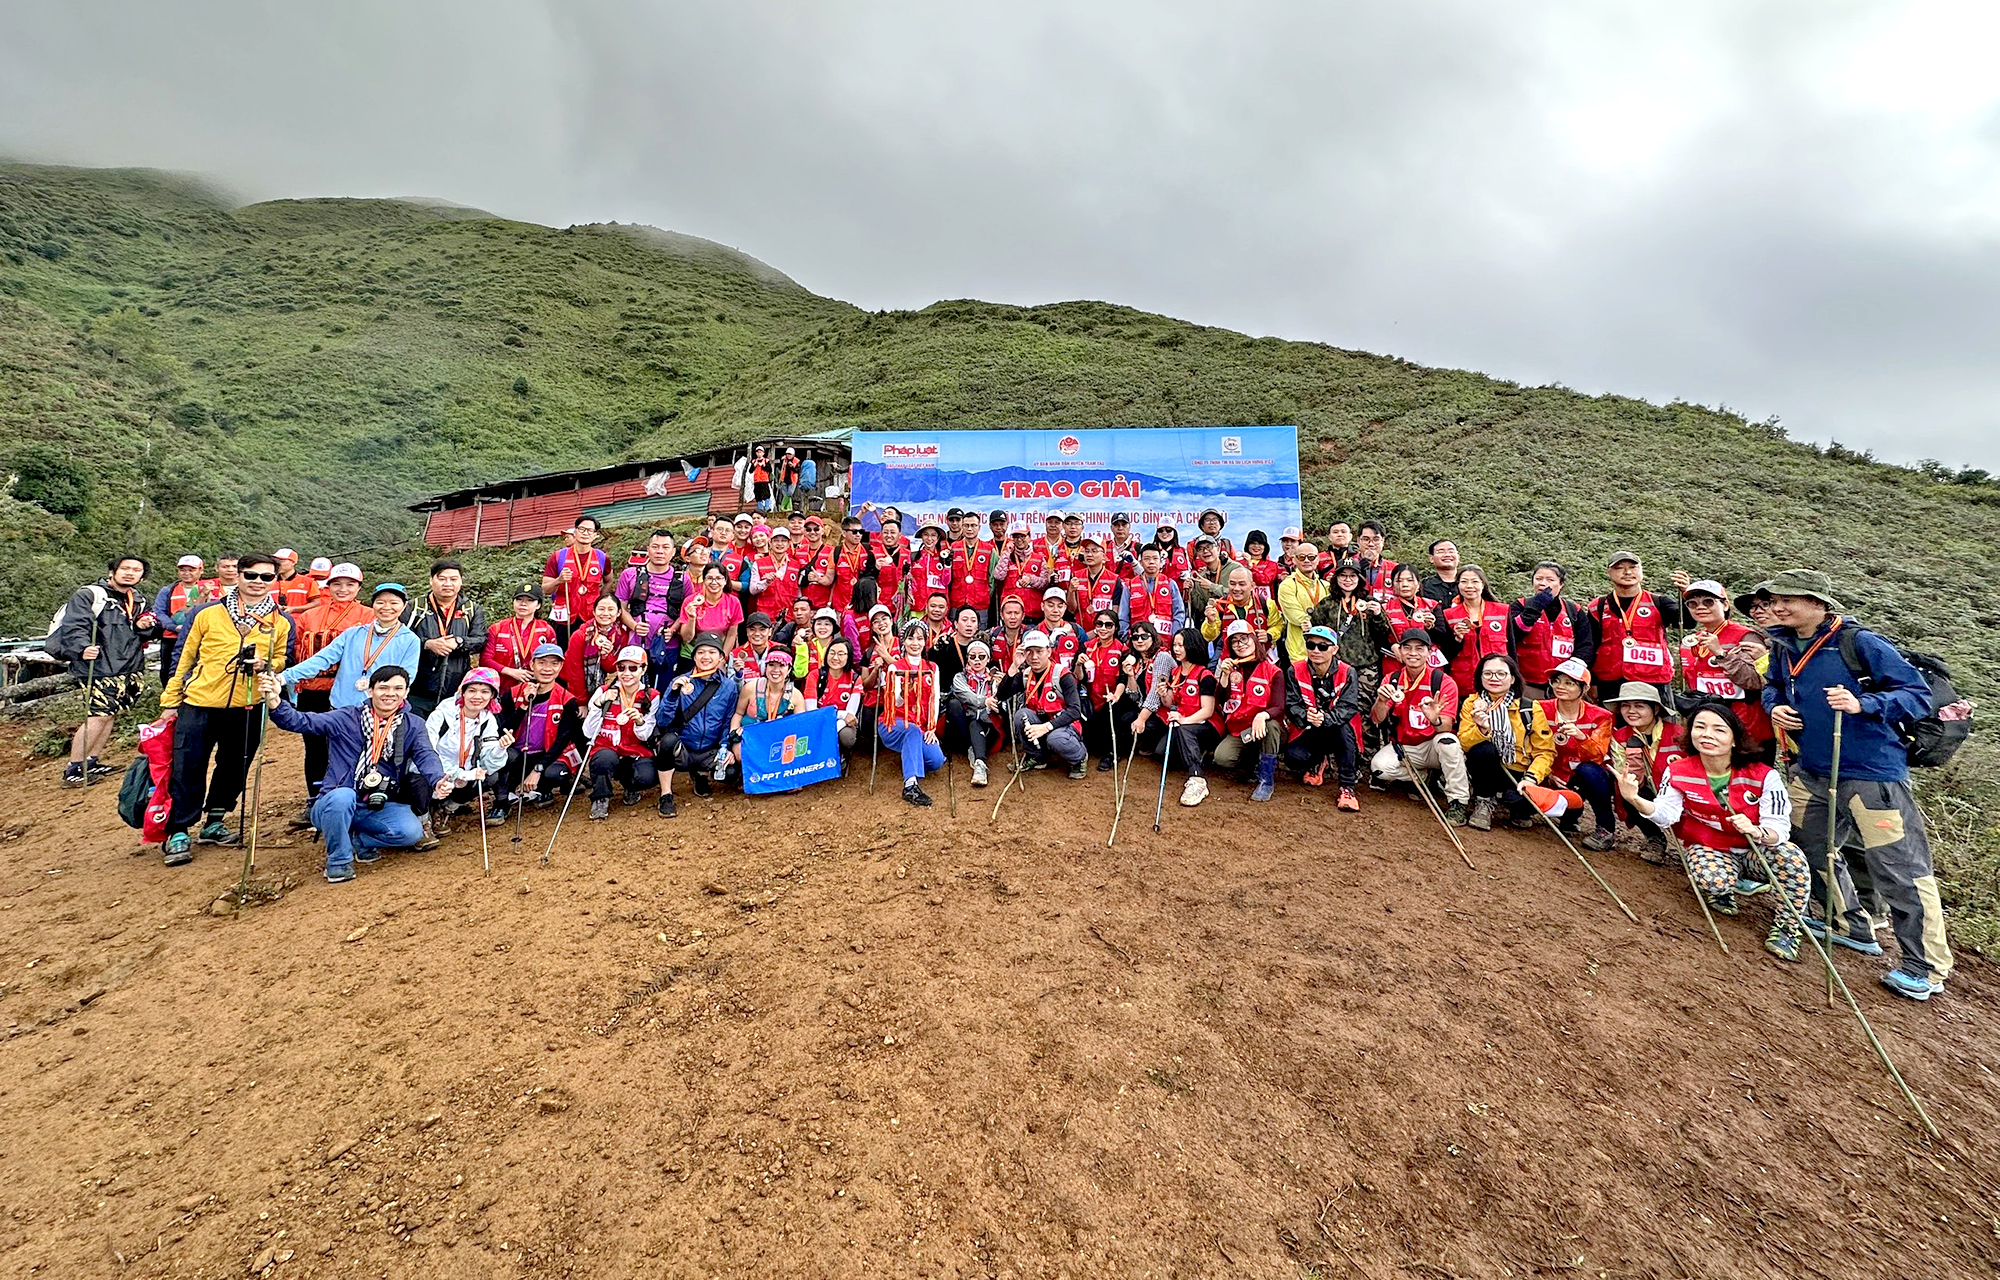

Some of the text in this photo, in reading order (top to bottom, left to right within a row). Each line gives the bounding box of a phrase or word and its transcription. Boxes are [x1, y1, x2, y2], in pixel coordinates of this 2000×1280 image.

[1000, 475, 1140, 499] TRAO GIẢI
[1021, 509, 1045, 524] TRÊN
[1630, 649, 1656, 662] 045
[1705, 682, 1736, 696] 018
[761, 761, 826, 781] FPT RUNNERS
